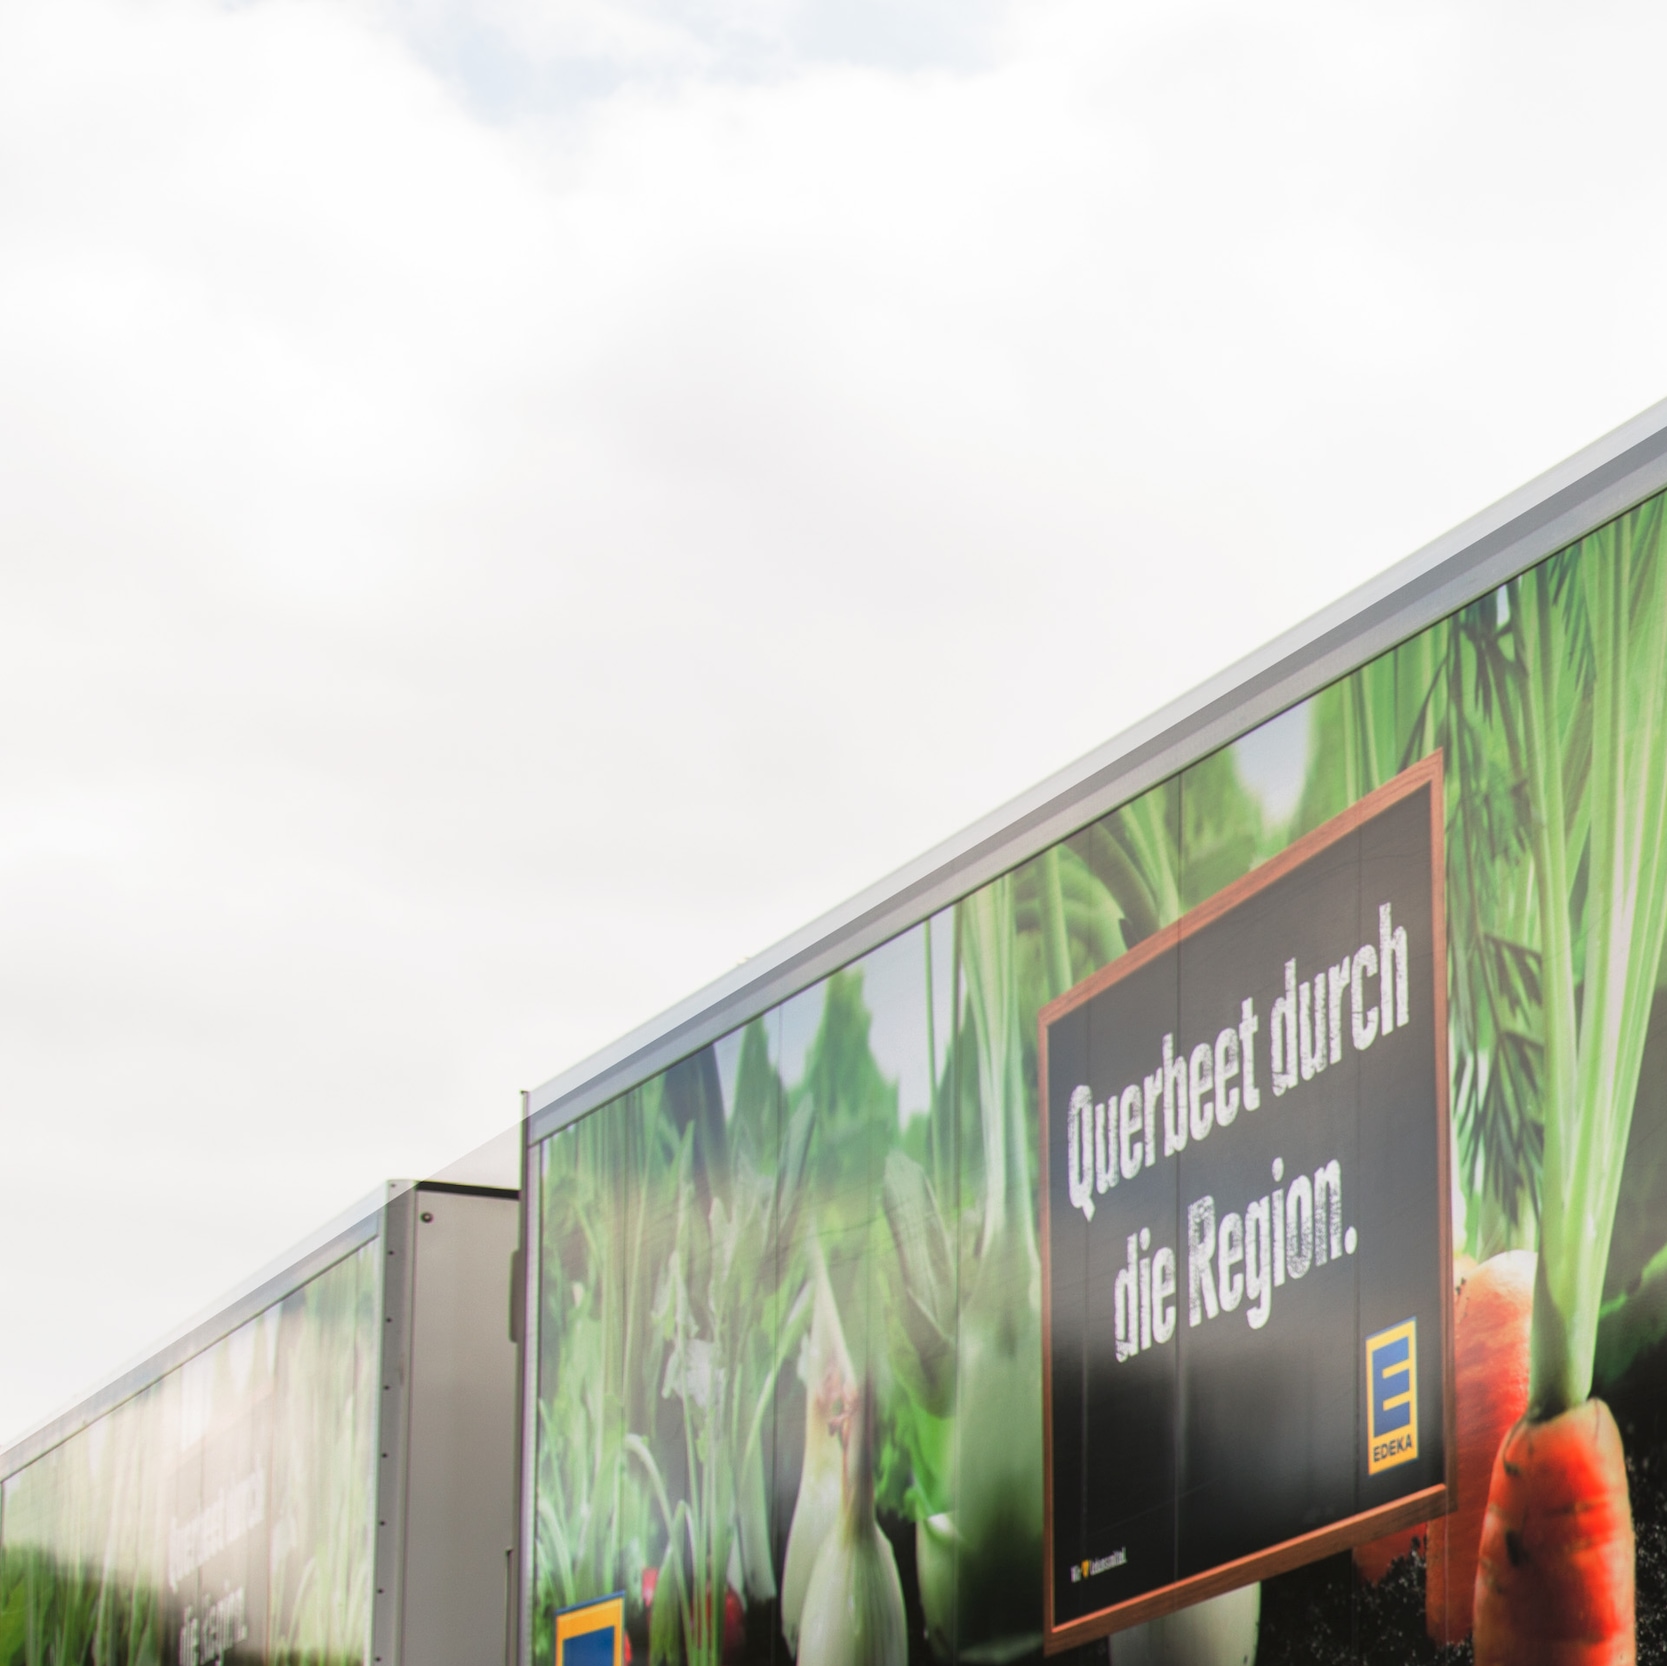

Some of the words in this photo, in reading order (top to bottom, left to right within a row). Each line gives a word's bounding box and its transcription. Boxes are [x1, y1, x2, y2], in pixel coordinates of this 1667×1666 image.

[1066, 997, 1261, 1223] Querbeet
[1270, 901, 1410, 1097] durch
[1113, 1227, 1176, 1363] die
[1187, 1154, 1360, 1331] Region.
[1372, 1432, 1414, 1464] EDEKA
